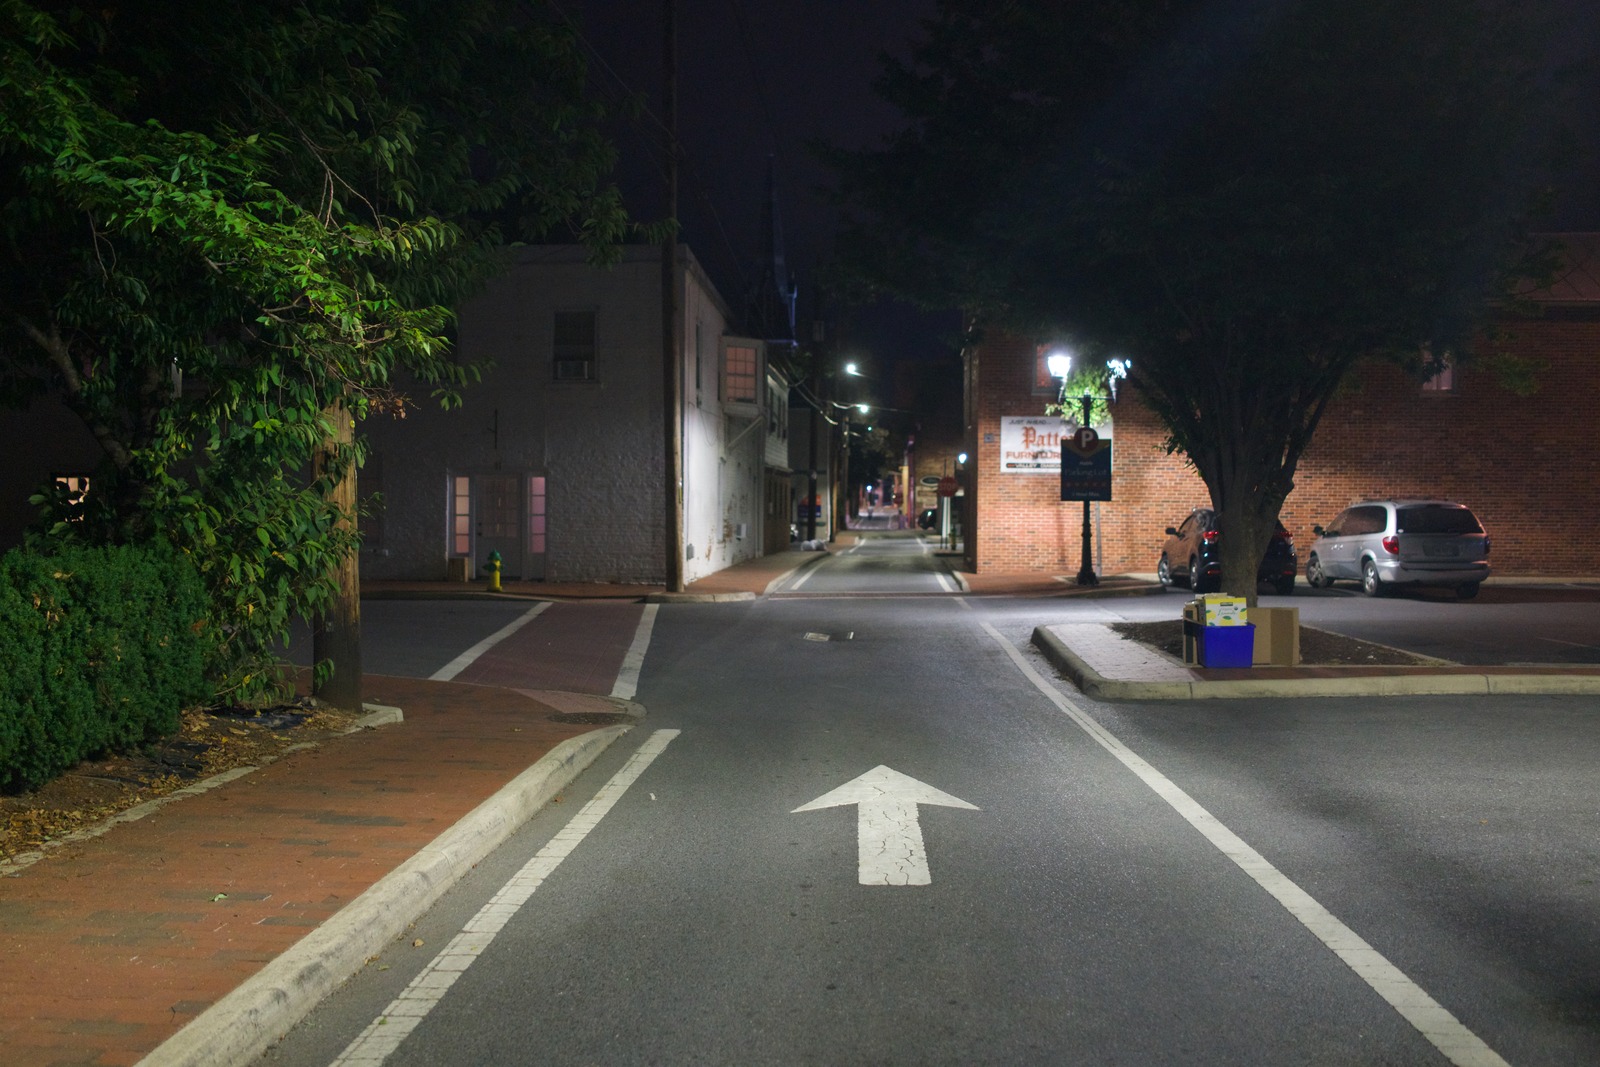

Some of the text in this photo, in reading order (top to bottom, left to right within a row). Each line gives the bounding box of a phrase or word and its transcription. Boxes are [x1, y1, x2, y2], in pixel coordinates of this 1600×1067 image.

[1022, 426, 1074, 449] Patt
[1081, 429, 1094, 448] P
[1006, 451, 1062, 459] FURNITUR
[939, 482, 957, 490] STOP
